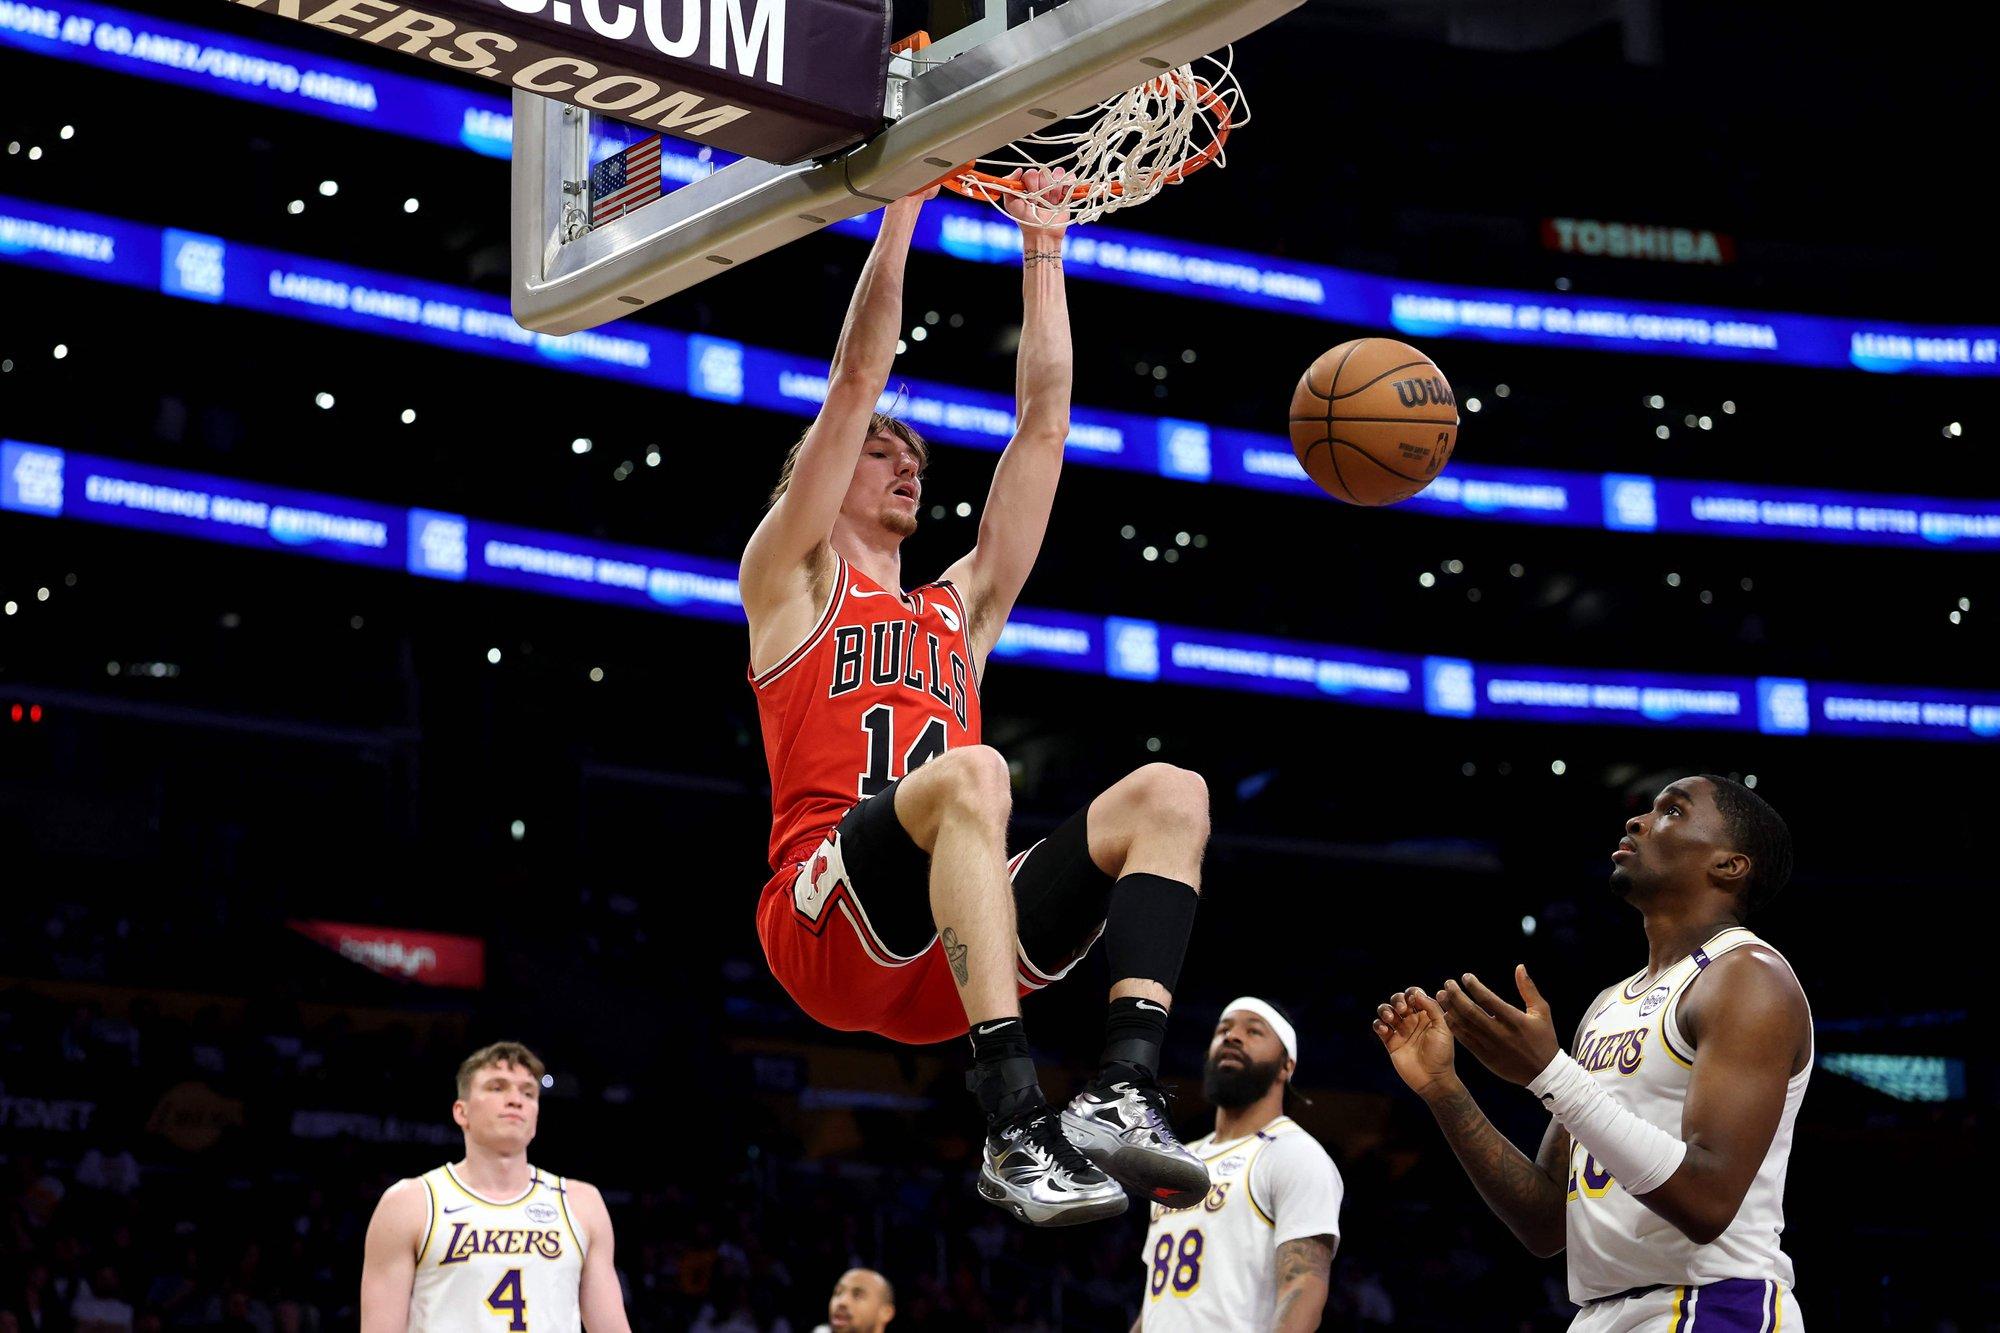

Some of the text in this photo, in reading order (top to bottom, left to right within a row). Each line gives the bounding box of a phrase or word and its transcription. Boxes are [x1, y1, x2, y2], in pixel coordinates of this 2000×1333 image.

[1552, 218, 1722, 264] TOSHIBA
[828, 619, 968, 732] BULLS
[858, 703, 948, 798] 14
[437, 1221, 563, 1267] LAKERS
[1150, 1227, 1204, 1301] 88
[482, 1267, 529, 1333] 4
